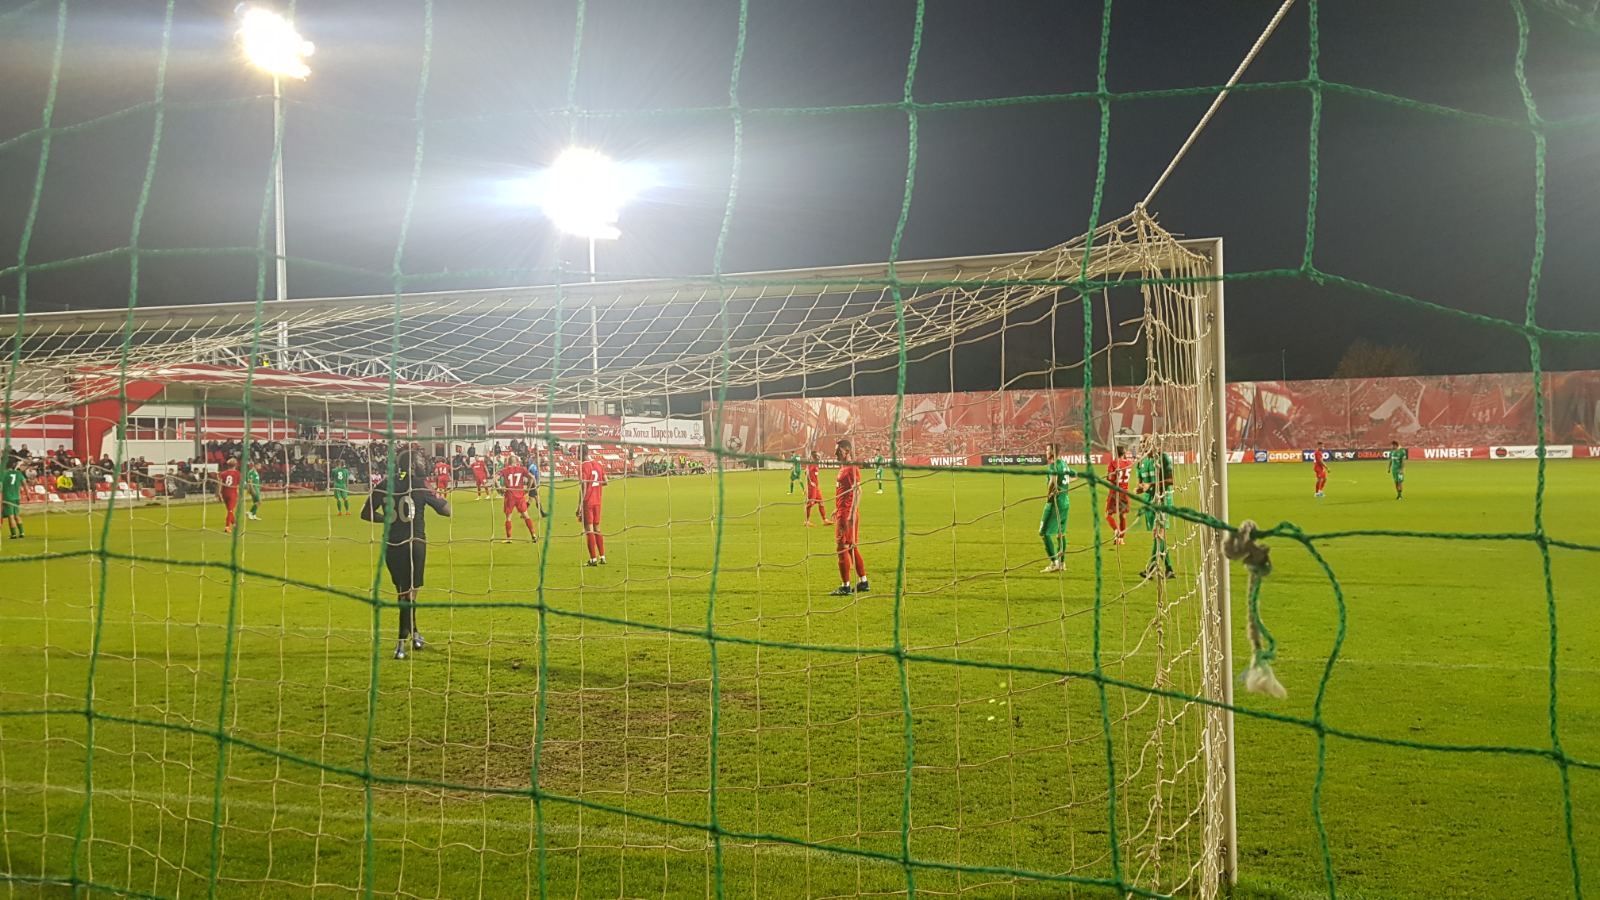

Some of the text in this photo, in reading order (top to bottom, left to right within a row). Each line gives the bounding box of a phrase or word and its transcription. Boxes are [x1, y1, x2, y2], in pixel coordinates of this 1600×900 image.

[1424, 448, 1473, 458] WINBET
[930, 457, 968, 466] WINBET
[337, 472, 343, 480] 8
[439, 467, 447, 475] 14
[1118, 468, 1131, 483] 25
[10, 474, 17, 485] 7
[225, 475, 233, 487] 8
[507, 473, 522, 487] 17
[592, 470, 599, 487] 2
